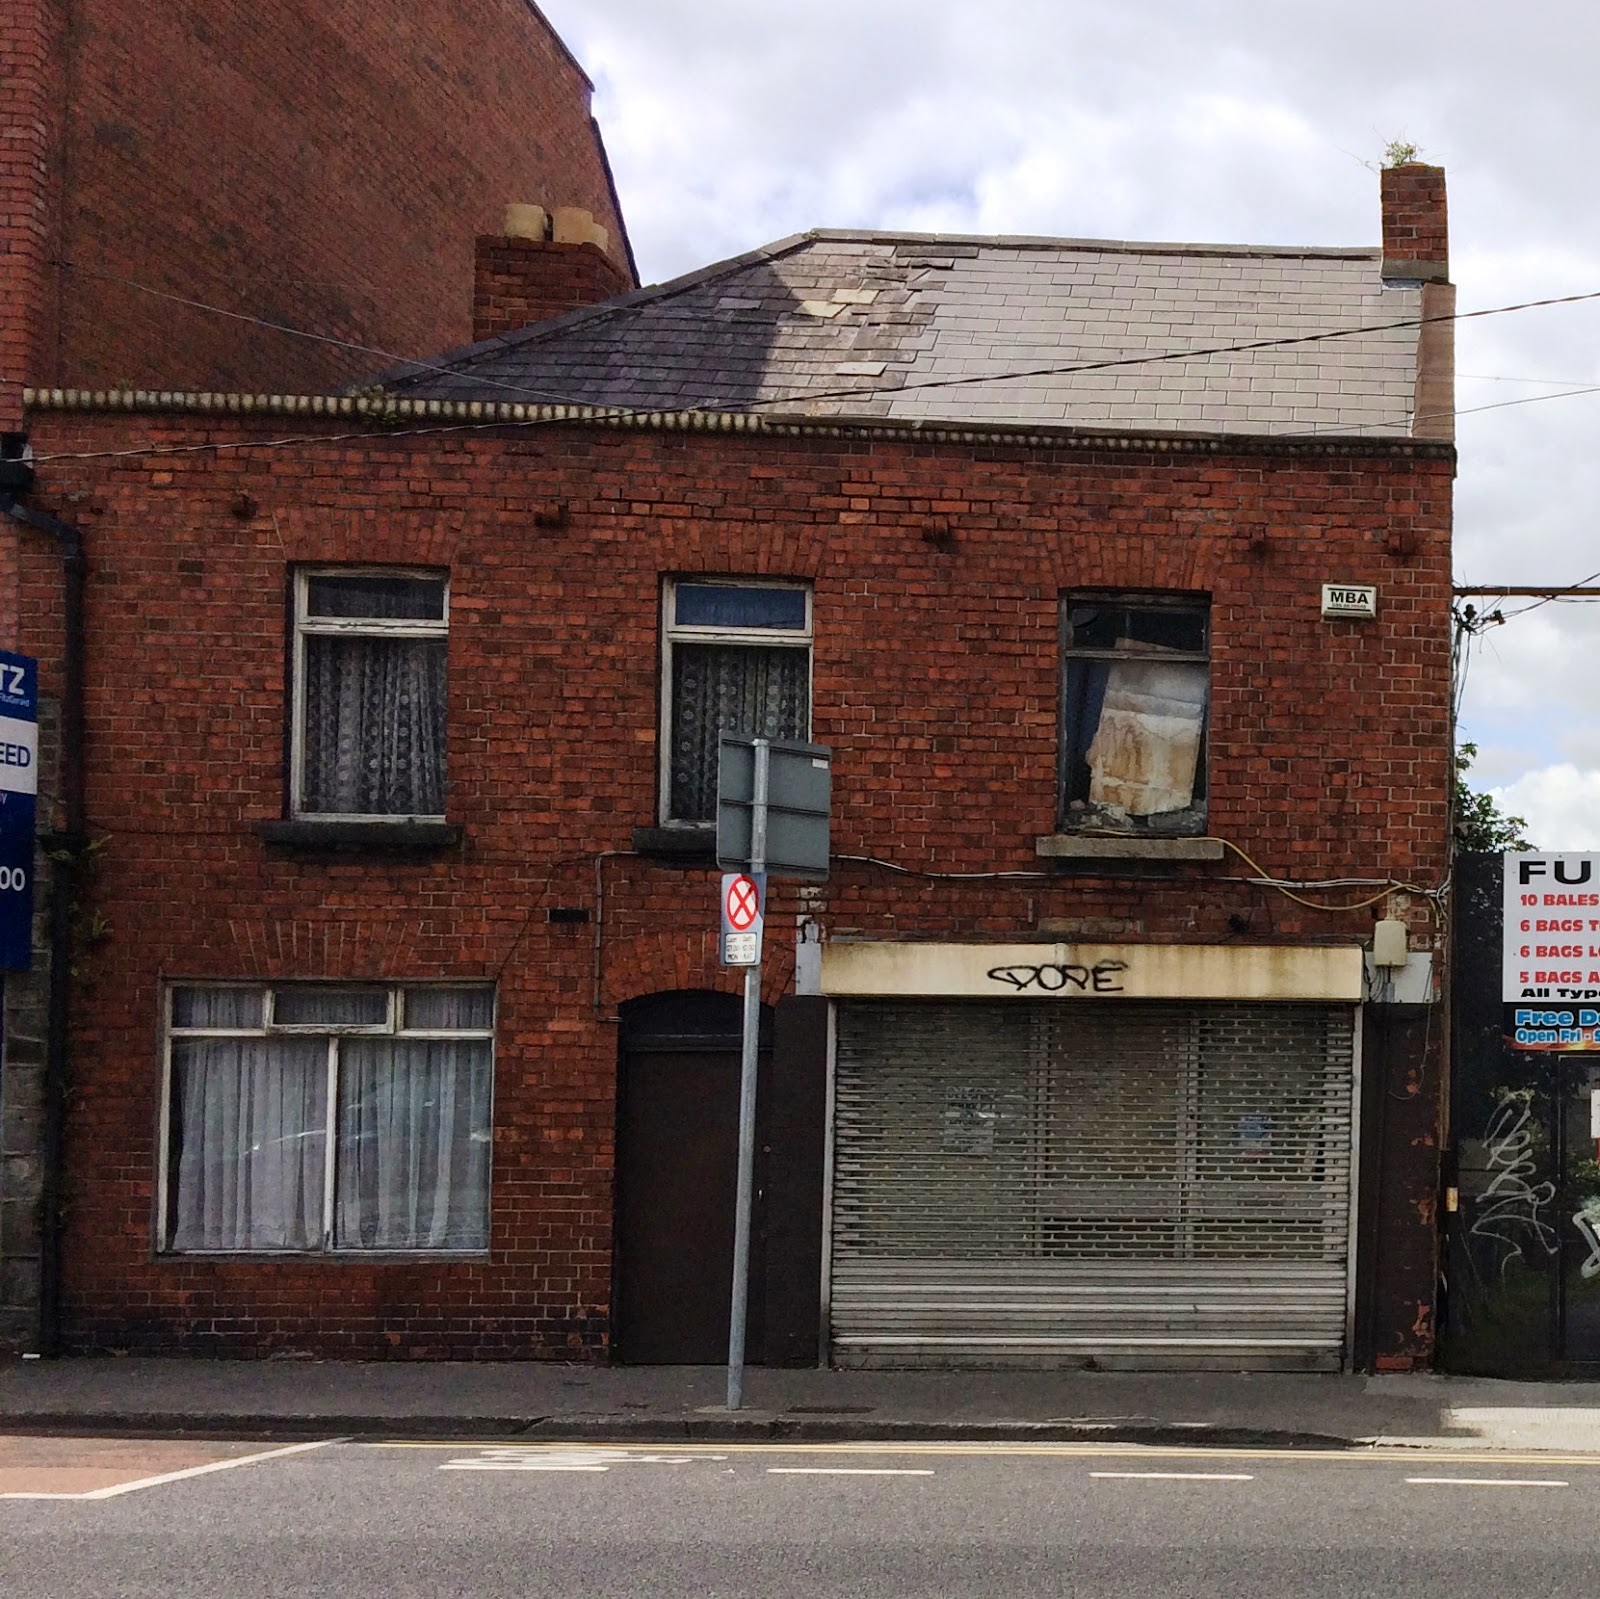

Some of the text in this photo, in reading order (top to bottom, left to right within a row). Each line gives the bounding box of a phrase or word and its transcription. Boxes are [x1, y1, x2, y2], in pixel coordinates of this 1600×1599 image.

[1330, 591, 1369, 604] MBA
[1519, 861, 1591, 884] FU
[1520, 894, 1599, 906] 10 BALES
[1520, 919, 1600, 932] 6 BAGS T
[1520, 945, 1600, 958] 6 BAGS L
[1520, 971, 1529, 983] 5
[1535, 971, 1582, 983] BAGS
[1521, 988, 1600, 999] All Typ
[1515, 1009, 1600, 1026] Free D
[1516, 1028, 1557, 1044] Open
[1560, 1028, 1582, 1043] Fri
